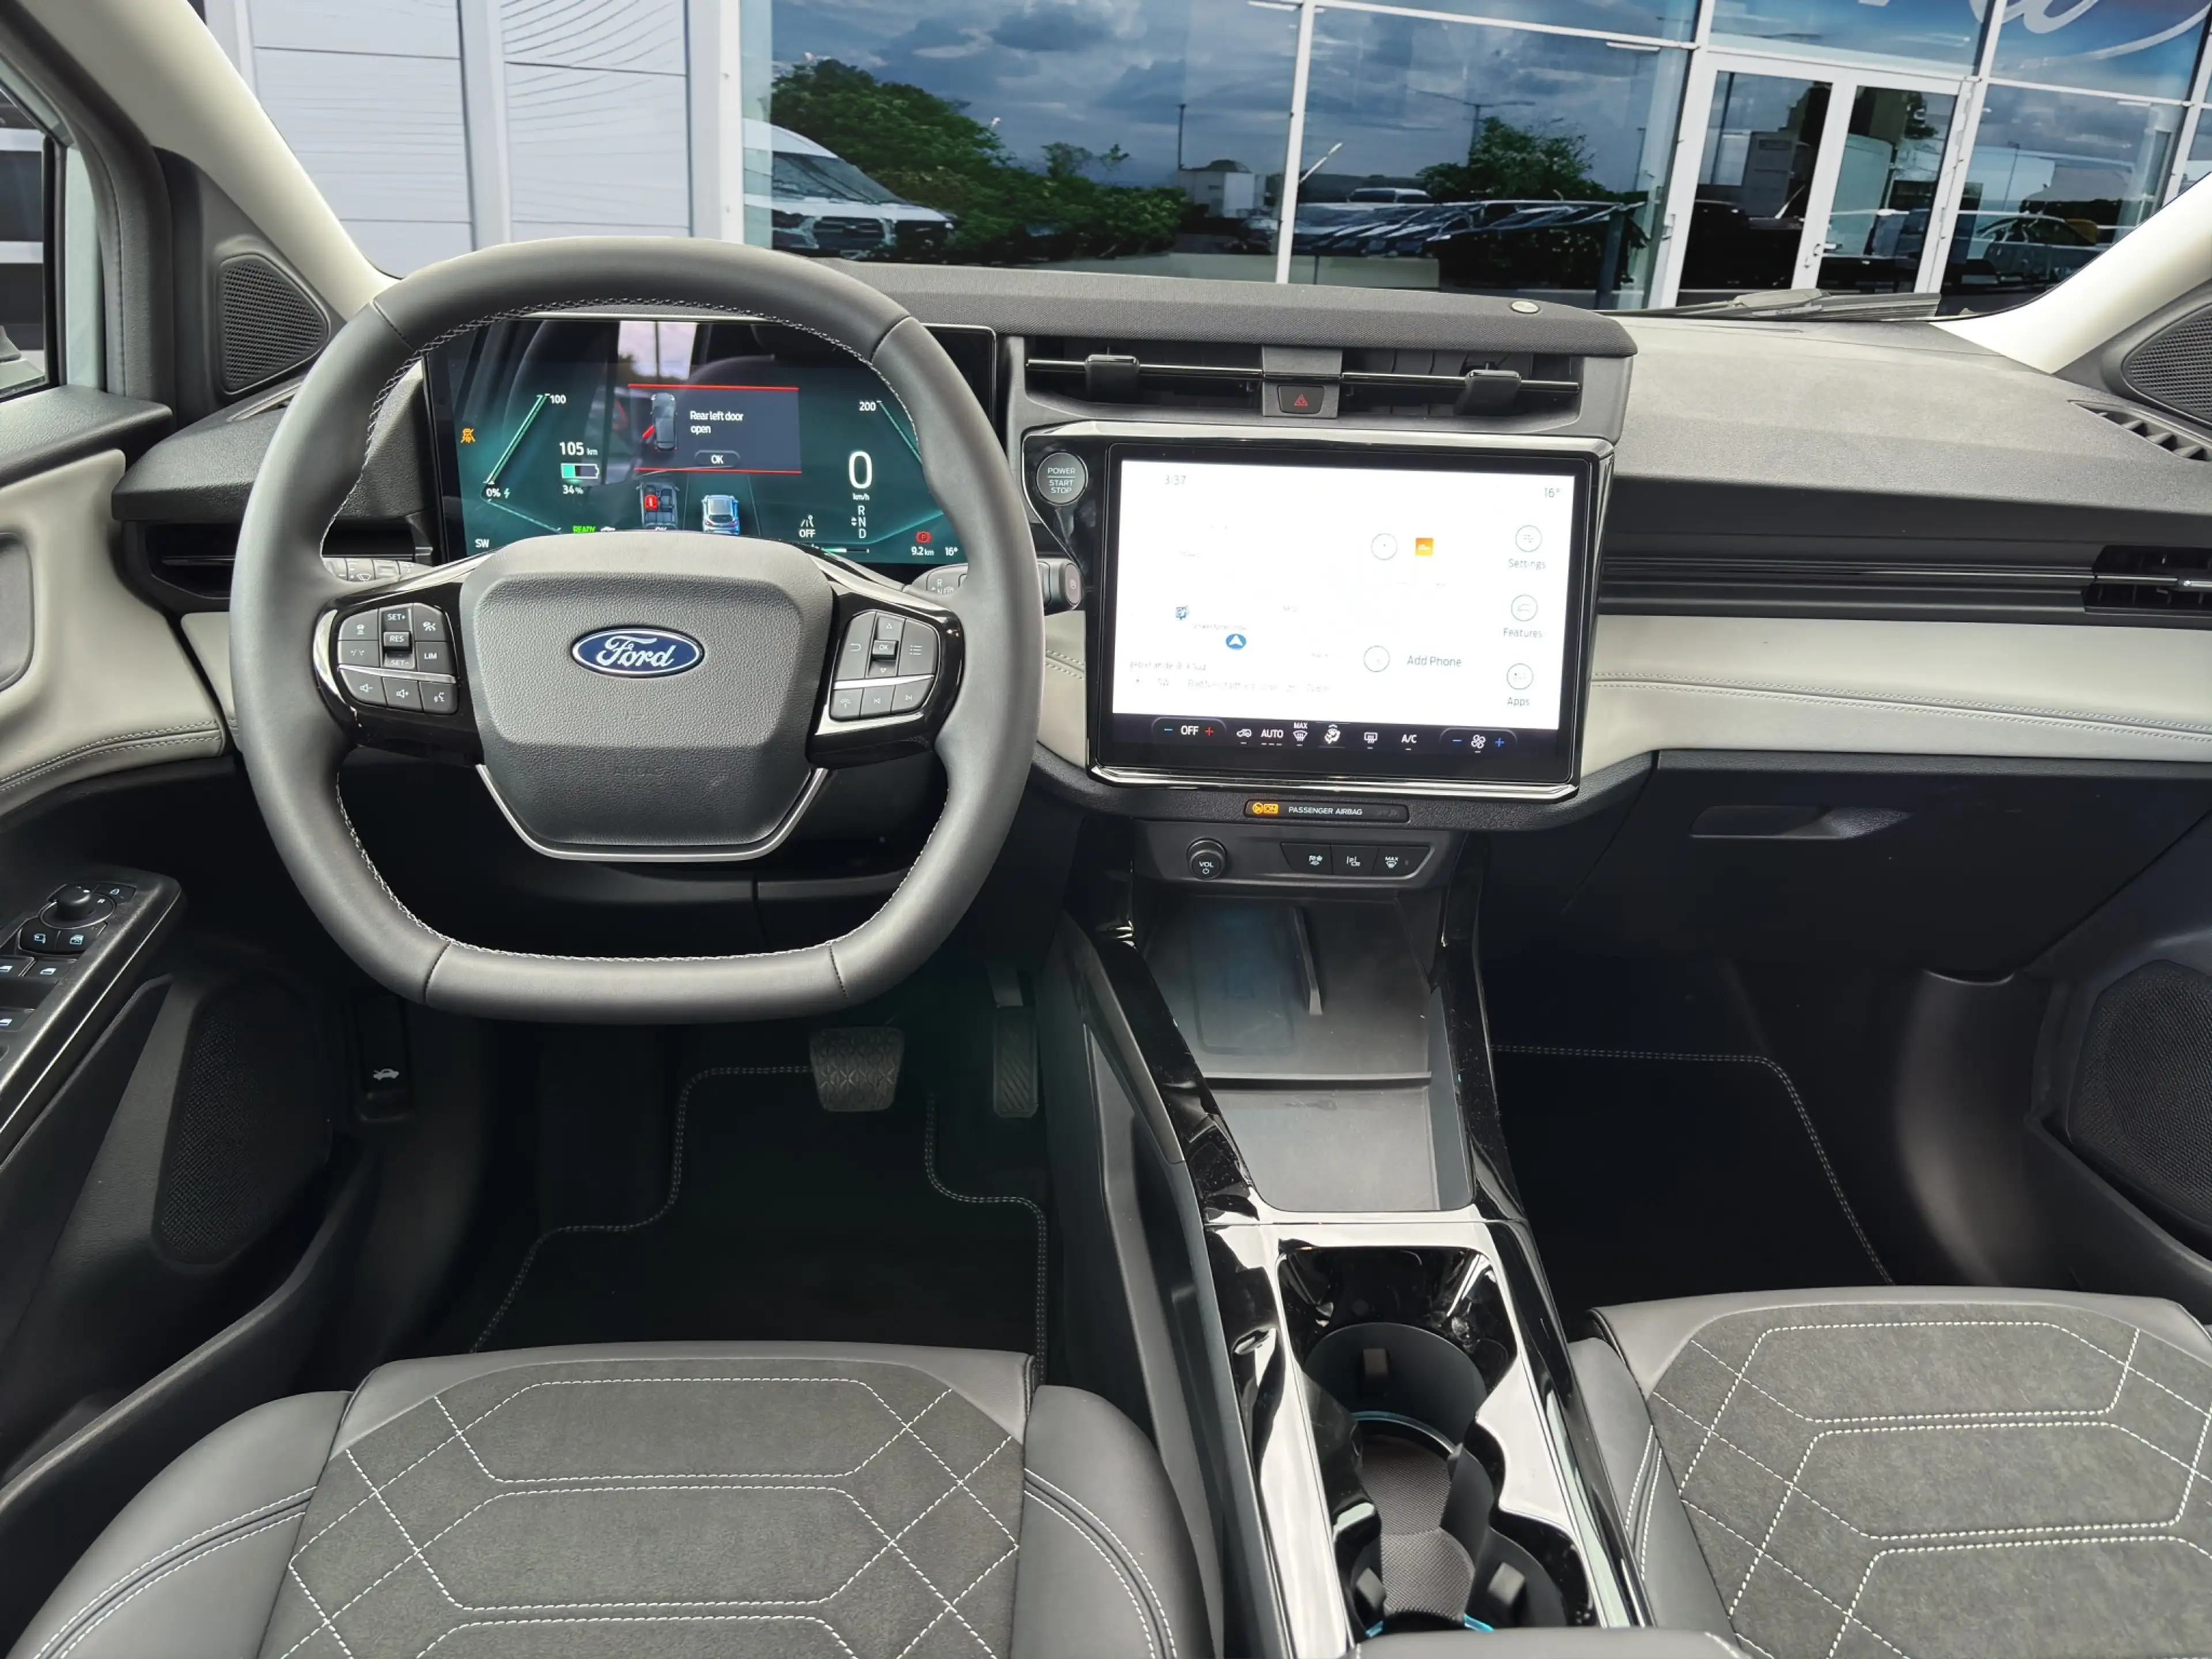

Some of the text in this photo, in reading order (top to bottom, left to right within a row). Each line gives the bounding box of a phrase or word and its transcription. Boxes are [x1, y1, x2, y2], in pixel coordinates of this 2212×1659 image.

[550, 394, 566, 404] 100
[859, 402, 877, 411] 200
[690, 410, 744, 422] Rear left door
[691, 425, 711, 435] open
[559, 441, 598, 456] 105 km
[711, 454, 724, 464] OK
[849, 451, 873, 488] 0
[486, 488, 501, 498] 0%
[853, 493, 870, 501] km/h
[858, 505, 865, 516] R
[858, 516, 866, 527] N
[799, 529, 816, 538] OFF
[859, 528, 867, 539] D
[475, 539, 490, 548] SW
[1508, 559, 1547, 570] Settings
[1503, 628, 1543, 638] Features
[596, 635, 677, 666] Ford
[1407, 656, 1462, 667] Add Phone
[1507, 697, 1530, 707] Apps
[1180, 725, 1199, 736] OFF
[1260, 729, 1284, 738] AUTO
[1402, 734, 1417, 744] A/C
[1288, 806, 1333, 815] PASSENGER
